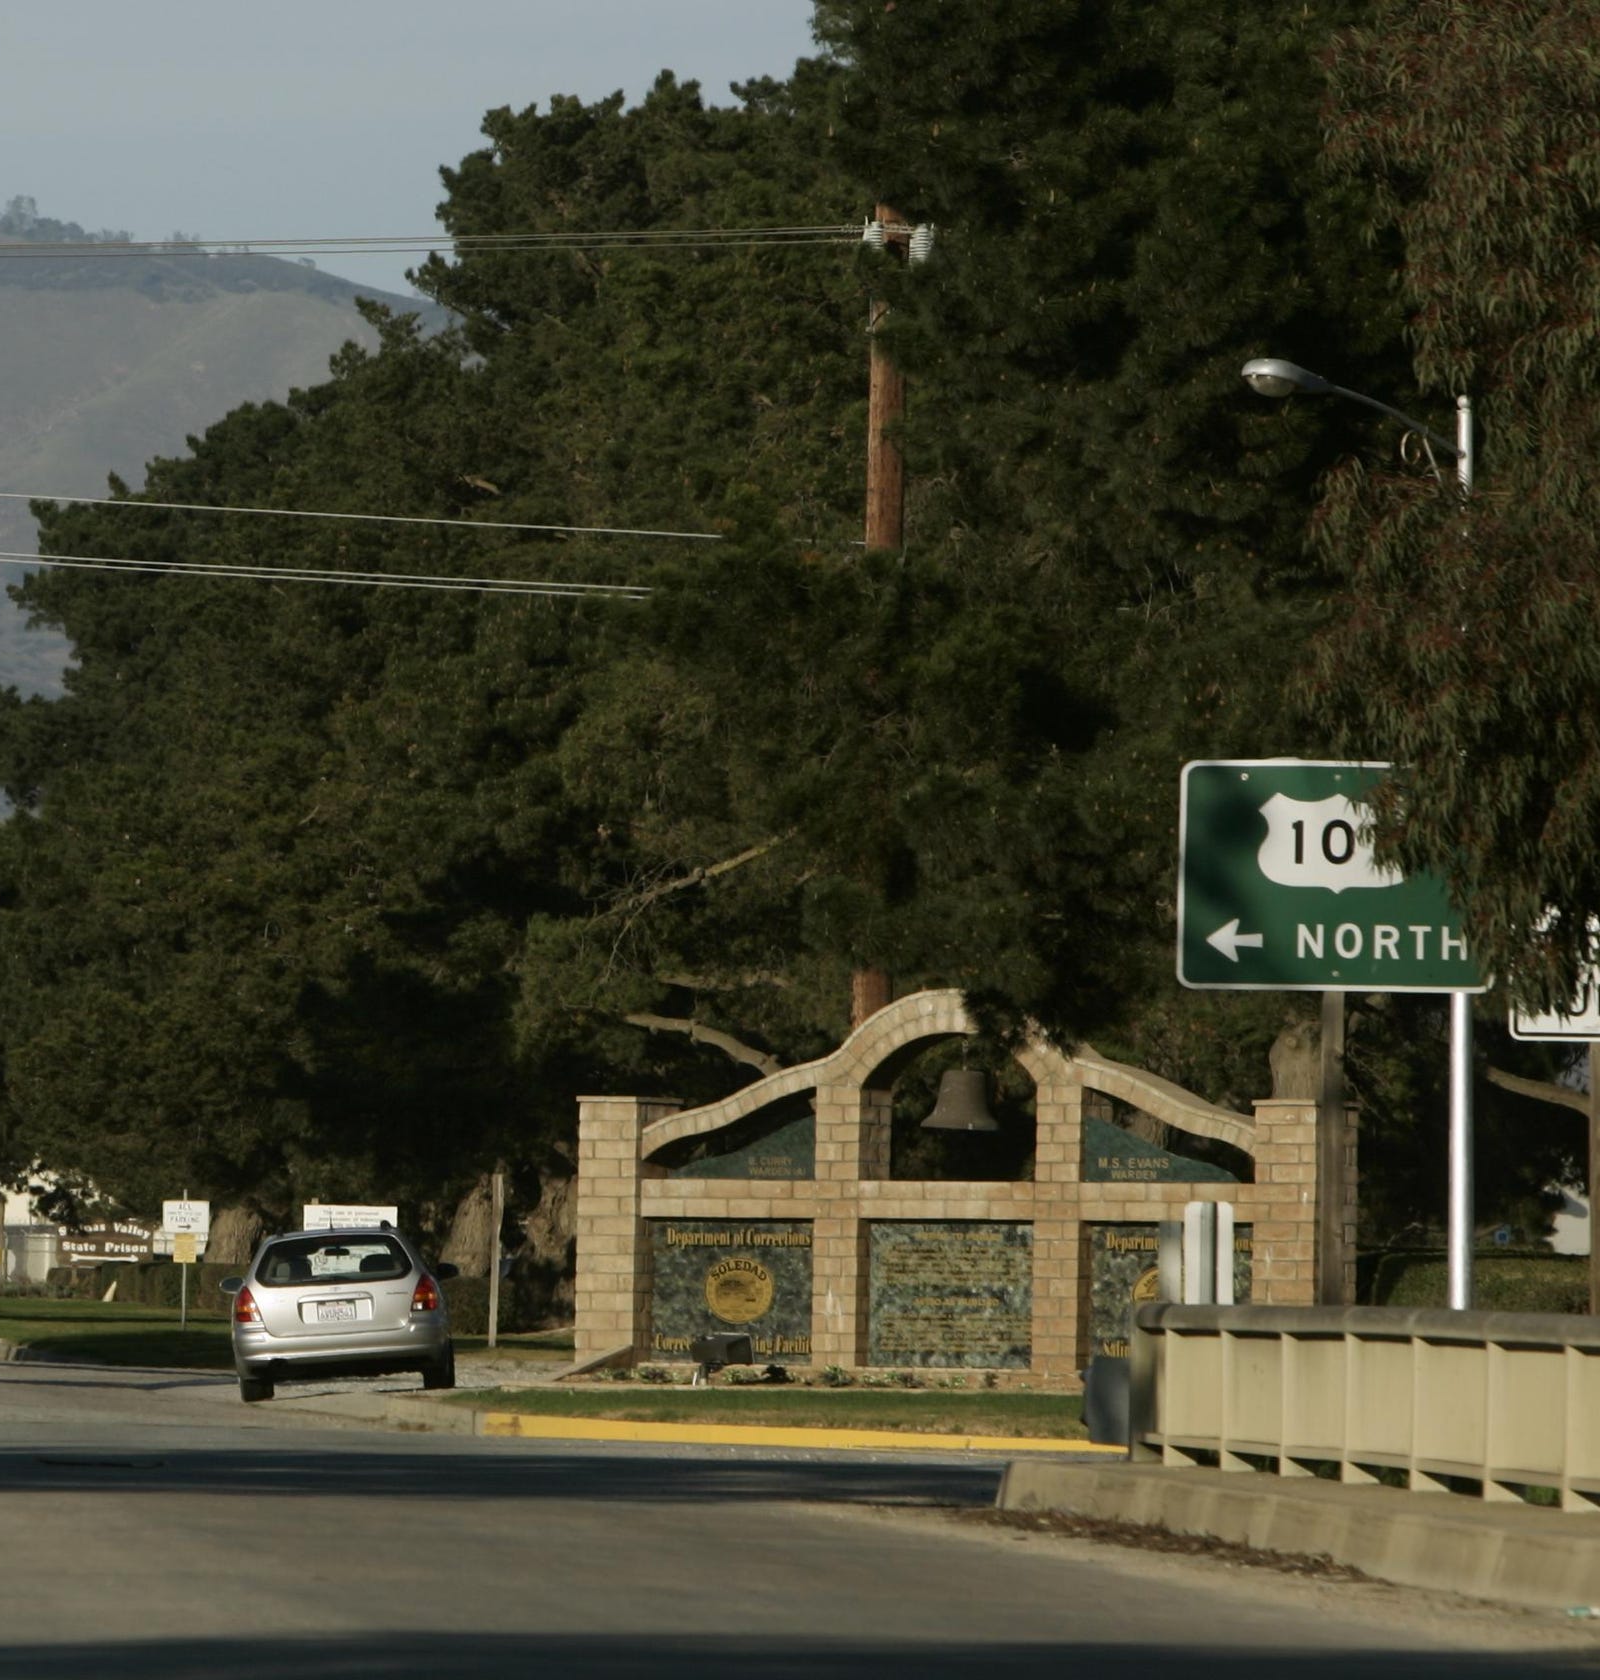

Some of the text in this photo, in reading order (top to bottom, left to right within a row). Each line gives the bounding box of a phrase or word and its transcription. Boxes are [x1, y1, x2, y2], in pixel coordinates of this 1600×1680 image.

[1292, 819, 1355, 865] 10
[1296, 922, 1469, 961] NORTH
[1128, 1157, 1169, 1169] EVANS
[1111, 1169, 1158, 1180] WARDEN
[113, 1222, 151, 1240] Valley
[666, 1227, 812, 1250] Department of Corrections
[62, 1241, 148, 1254] State Prison
[710, 1260, 767, 1281] SOLEDAD
